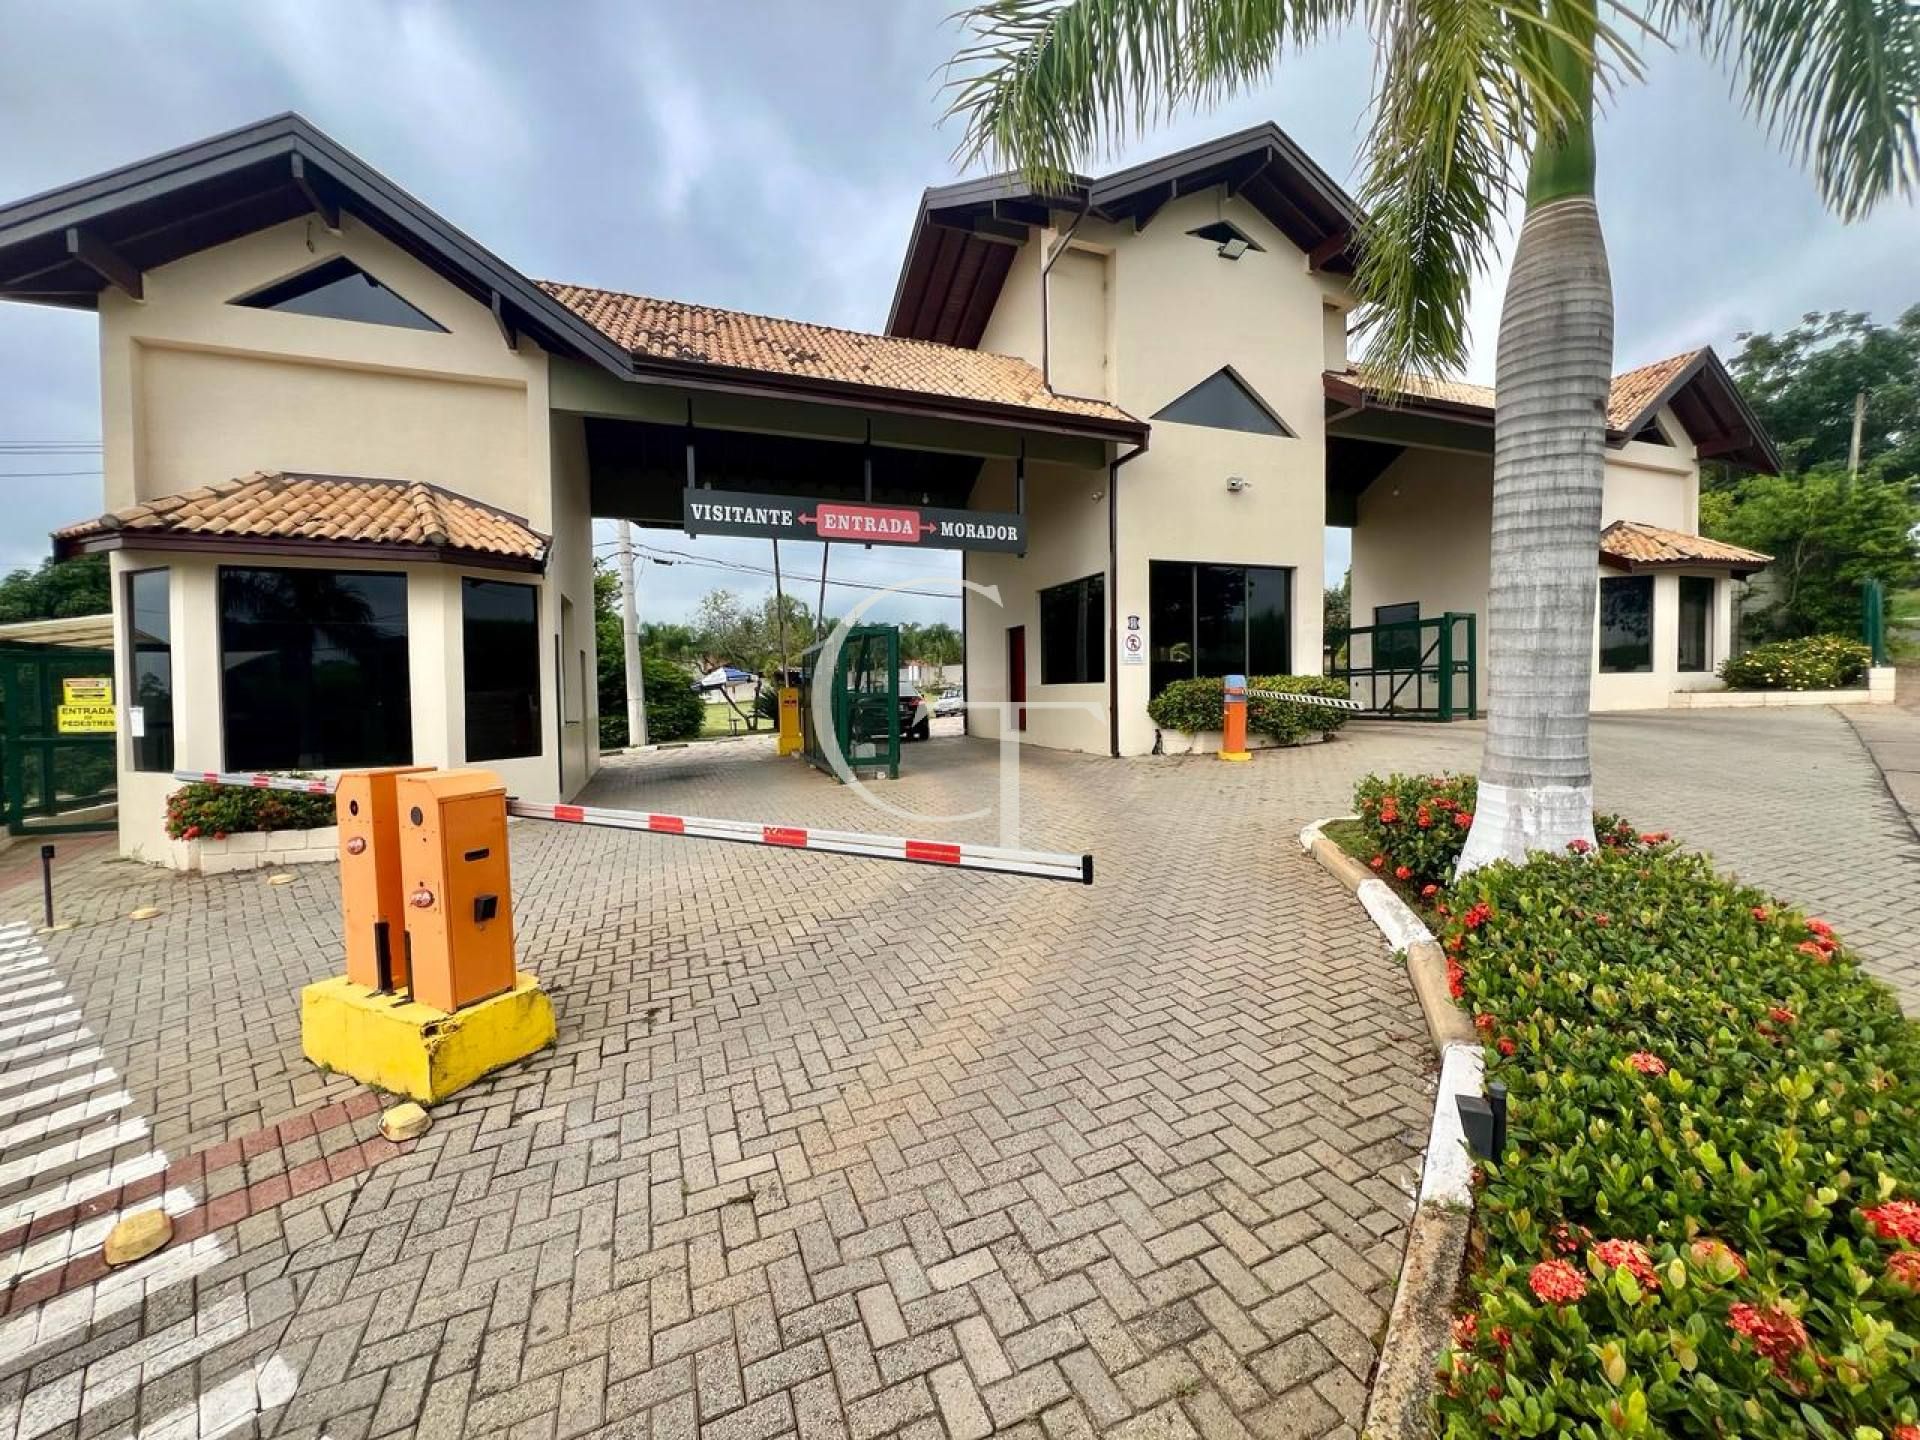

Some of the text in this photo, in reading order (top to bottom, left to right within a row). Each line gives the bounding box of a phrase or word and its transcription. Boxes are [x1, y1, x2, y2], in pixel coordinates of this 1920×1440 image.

[690, 503, 1019, 542] VISITANTE ENTRADA MORADOR
[62, 707, 115, 715] ENTRADA
